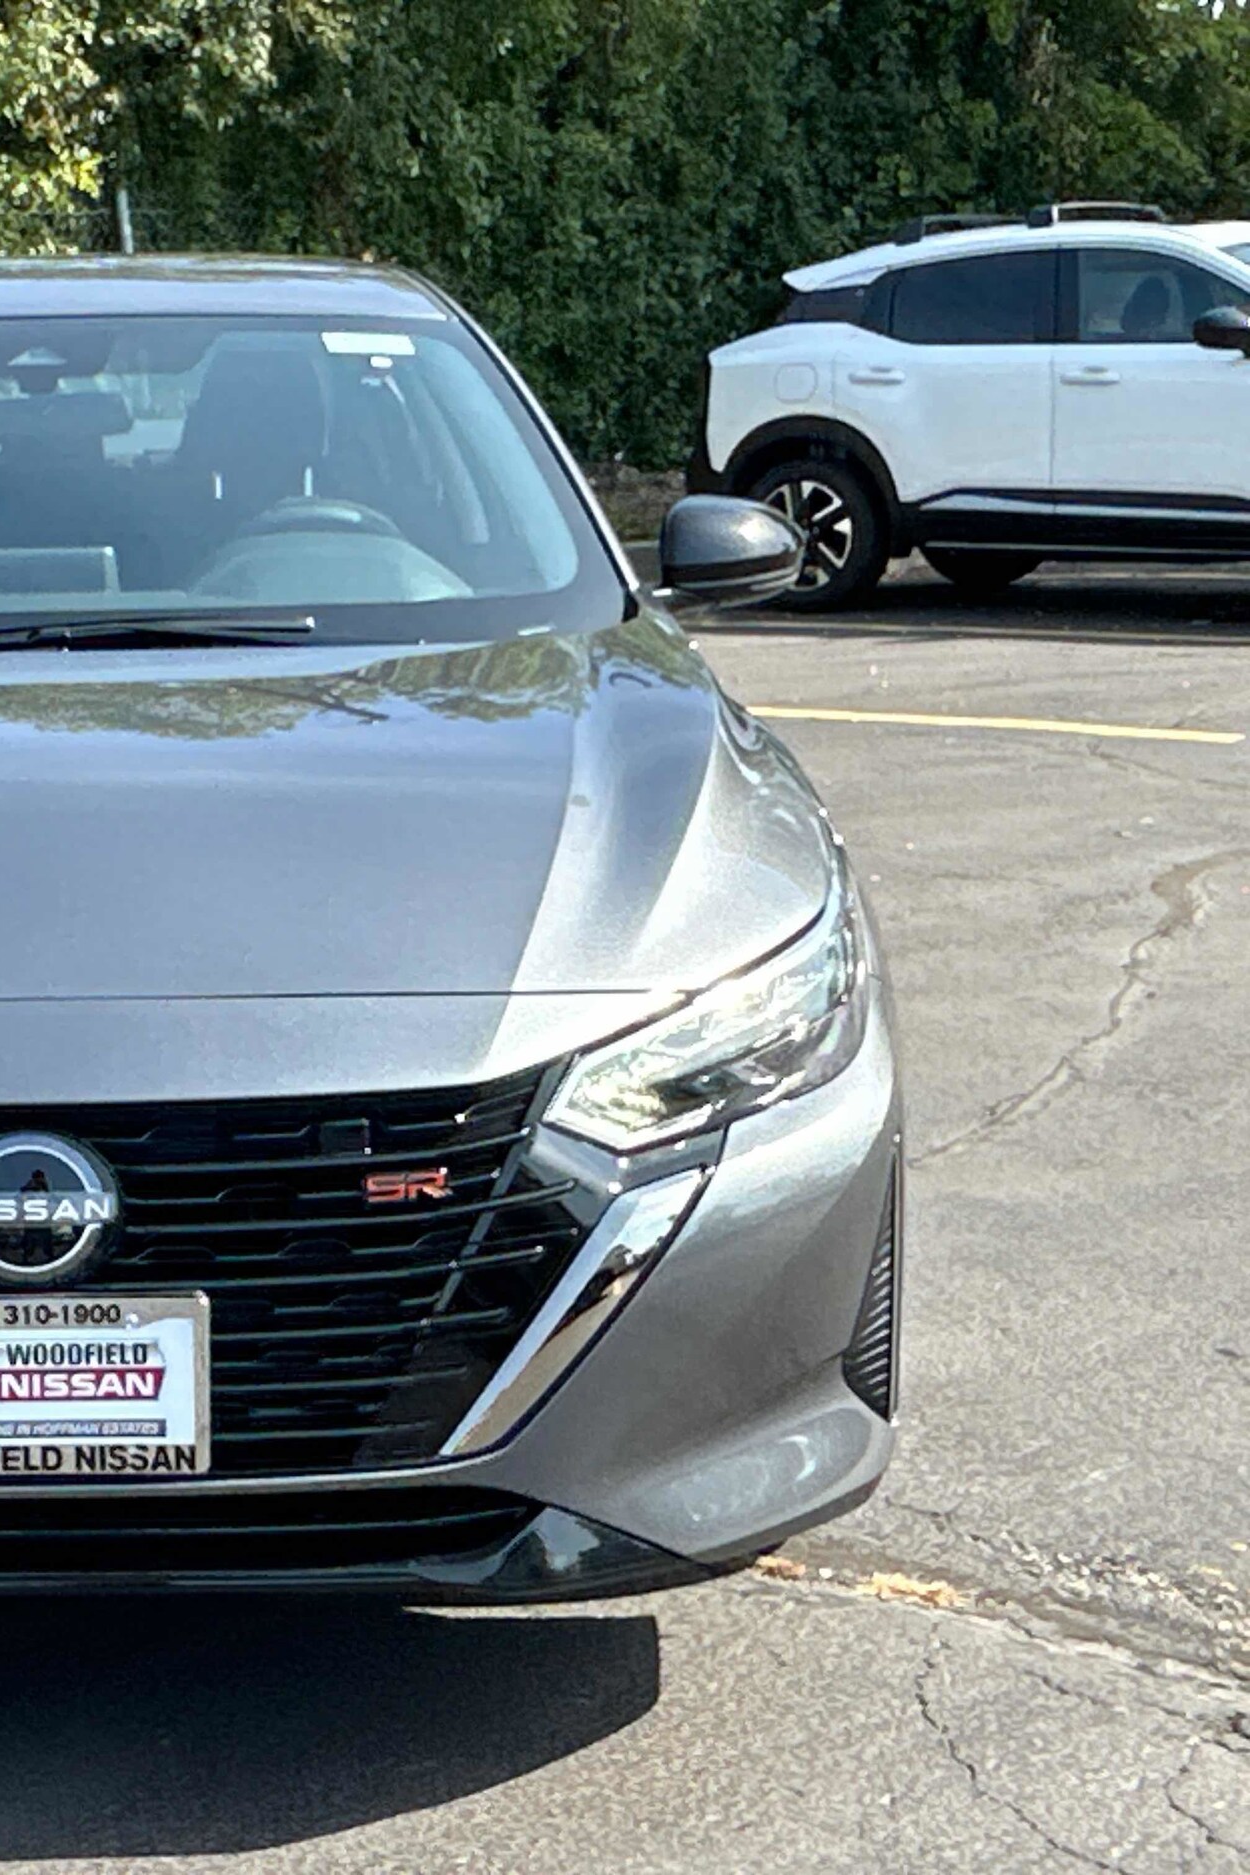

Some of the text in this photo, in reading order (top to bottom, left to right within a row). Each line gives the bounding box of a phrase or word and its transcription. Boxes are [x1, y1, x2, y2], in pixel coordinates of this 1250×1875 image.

[365, 1169, 452, 1203] SR
[3, 1303, 122, 1325] 310-1900
[6, 1342, 148, 1366] WOODFIELD
[0, 1372, 156, 1398] NISSAN
[75, 1444, 197, 1471] NISSAN
